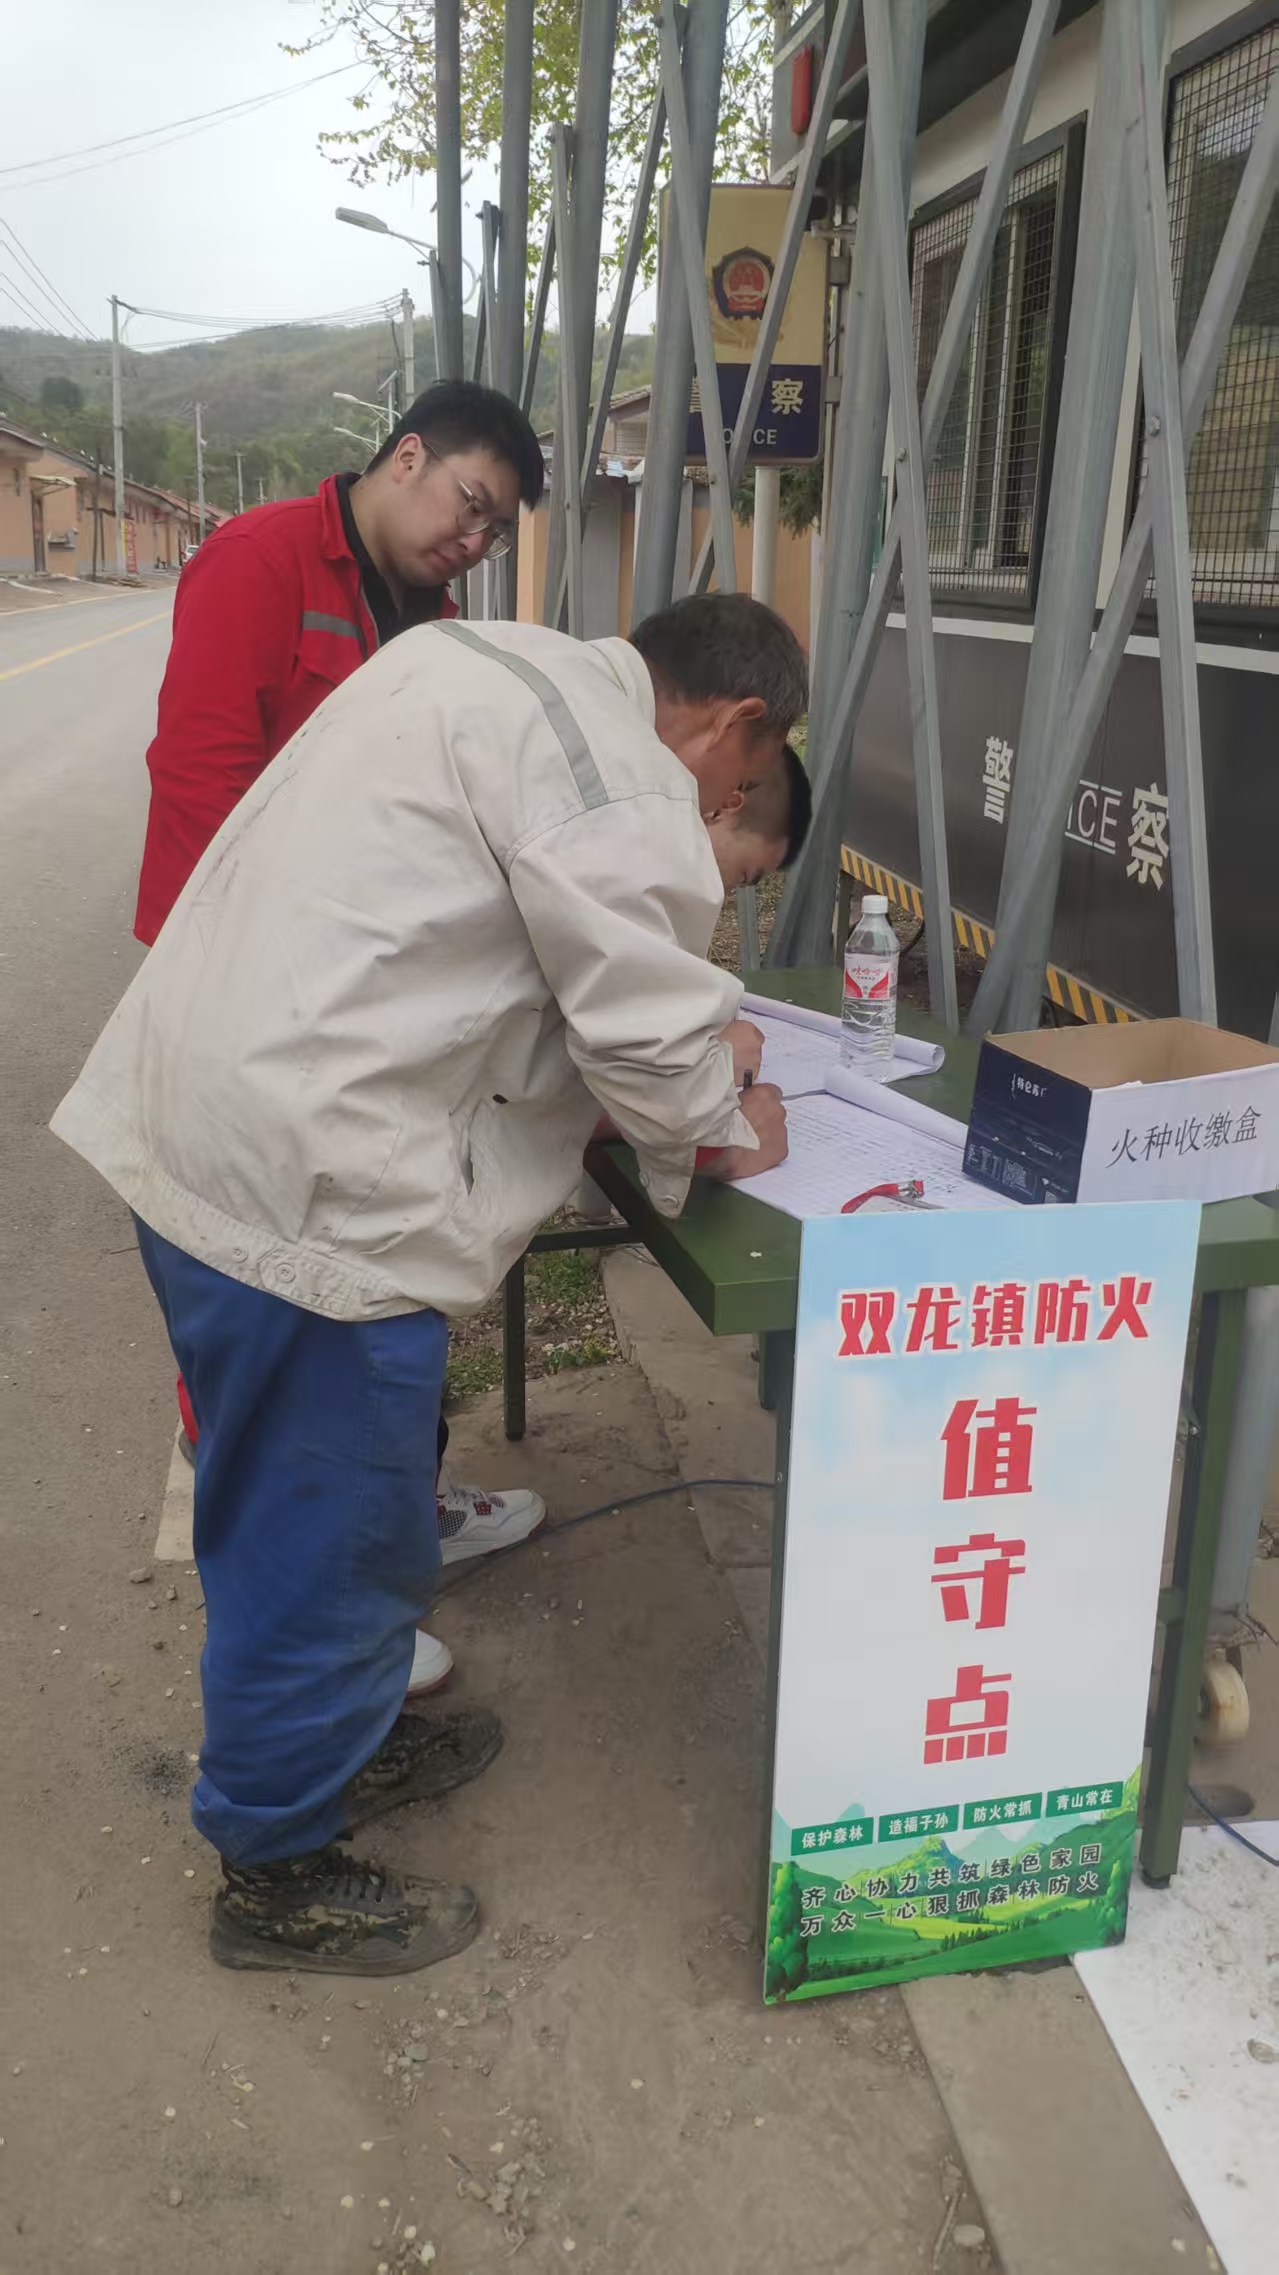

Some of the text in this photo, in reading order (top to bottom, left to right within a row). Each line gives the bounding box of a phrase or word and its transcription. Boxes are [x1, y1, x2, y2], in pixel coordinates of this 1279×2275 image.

[983, 736, 1014, 825] 警
[1126, 782, 1169, 890] 察
[1105, 1104, 1262, 1169] 火种收缴盒
[837, 1275, 1153, 1357] 双龙镇防火
[923, 1396, 1038, 1765] 值守点
[802, 1788, 1113, 1849] 保护森林 造福子孙 防火常抓 青山常在
[800, 1870, 1099, 1937] 万众一心狠抓森林防火
[801, 1844, 1101, 1909] 齐心协力共筑绿色家园
